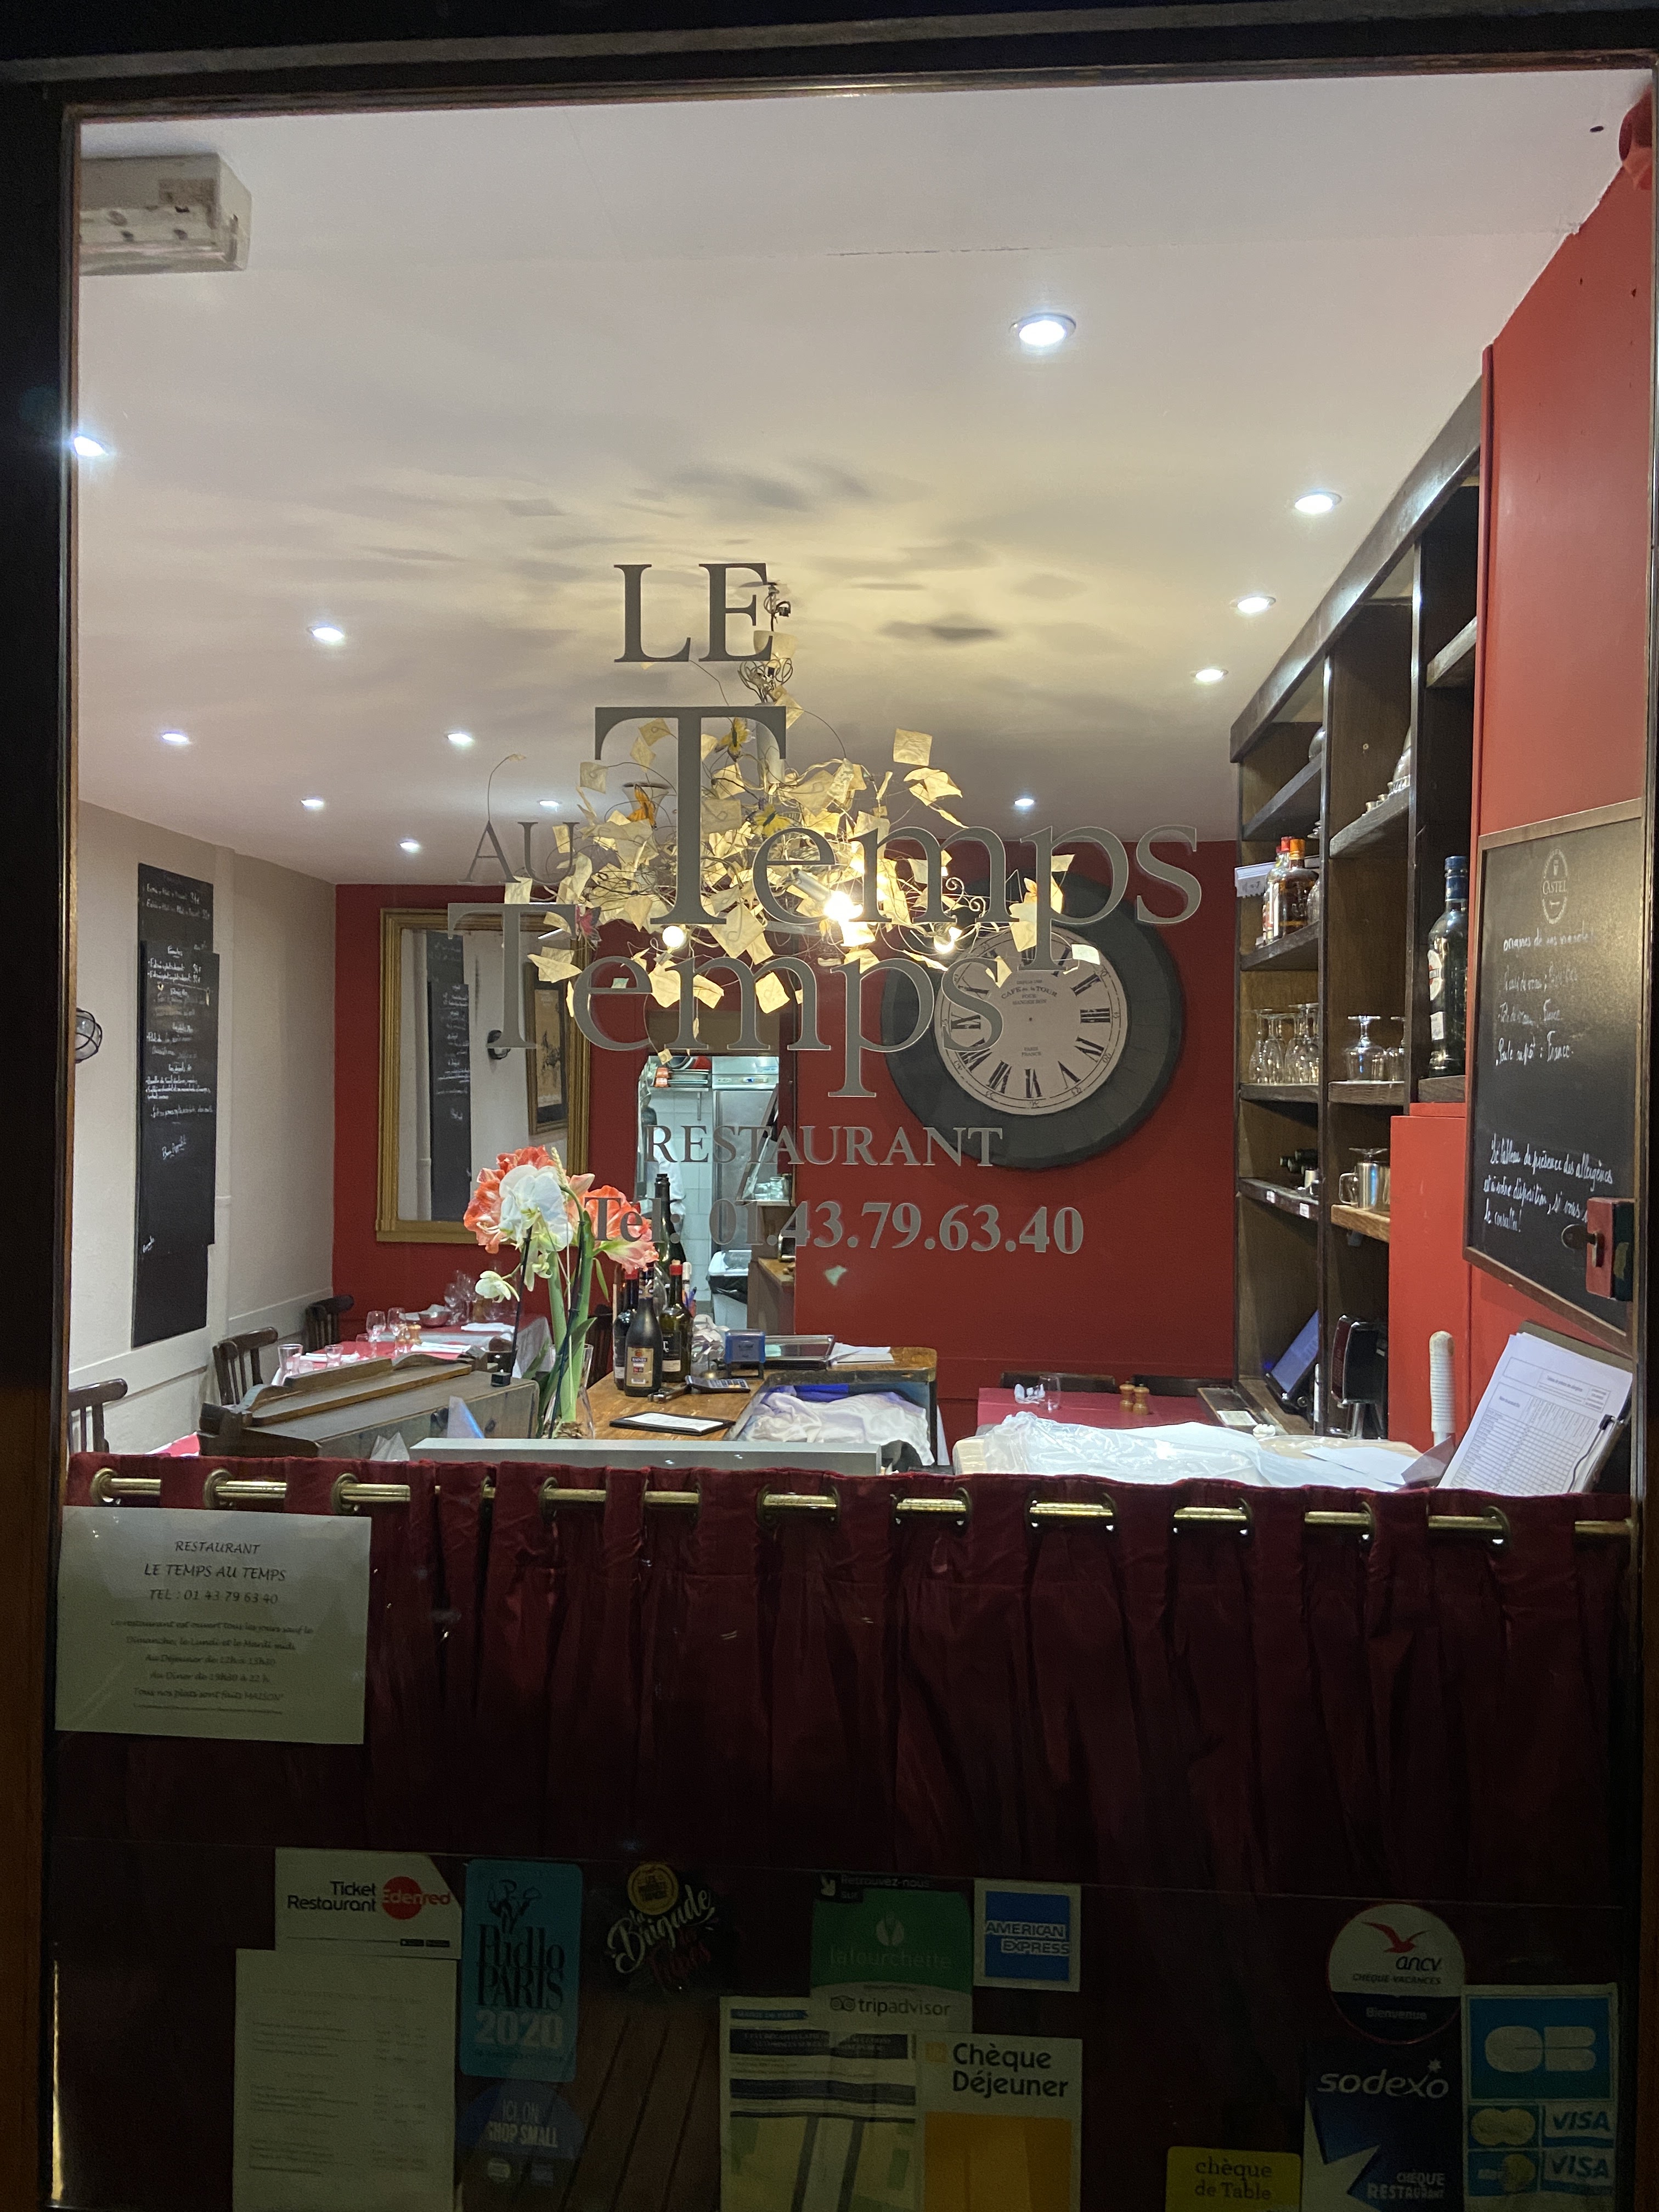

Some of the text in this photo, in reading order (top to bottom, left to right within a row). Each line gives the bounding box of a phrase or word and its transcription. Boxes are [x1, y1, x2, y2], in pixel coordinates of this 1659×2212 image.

[614, 563, 773, 662] LE
[595, 706, 1202, 971] Temps
[458, 821, 580, 883] AU
[1542, 879, 1567, 895] CASTEL
[448, 903, 1004, 1098] Temps
[1036, 985, 1058, 997] TOUR
[642, 1125, 1003, 1167] RESTAURANT
[709, 1198, 1085, 1254] 01.43.79.63.40
[175, 1541, 261, 1555] RESTAURANT
[144, 1563, 287, 1582] LE TEMPS AU TEMPS
[149, 1589, 172, 1601] TEL
[184, 1590, 199, 1601] 01
[205, 1590, 219, 1601] 43
[224, 1591, 240, 1602] 79
[244, 1592, 259, 1603] 63
[262, 1593, 278, 1605] 40
[330, 1881, 376, 1896] Ticket
[382, 1889, 451, 1905] Edenred
[287, 1894, 376, 1912] Restaurant
[986, 1921, 1064, 1938] AMERICAN
[1002, 1939, 1070, 1956] EXPRESS
[1395, 1956, 1443, 1972] ancv
[476, 1965, 564, 2011] PARIS
[858, 1996, 951, 2017] tripadvisor
[1365, 2006, 1427, 2021] Bienvenue
[474, 2010, 564, 2049] 2020
[952, 2042, 1052, 2073] Chèque
[953, 2069, 1069, 2099] Déjeuner
[1317, 2068, 1449, 2100] sodexo
[1552, 2111, 1610, 2132] VISA
[520, 2124, 558, 2148] SMALL
[1195, 2155, 1272, 2181] chèque
[1551, 2154, 1609, 2179] VISA
[1194, 2179, 1272, 2200] de Table
